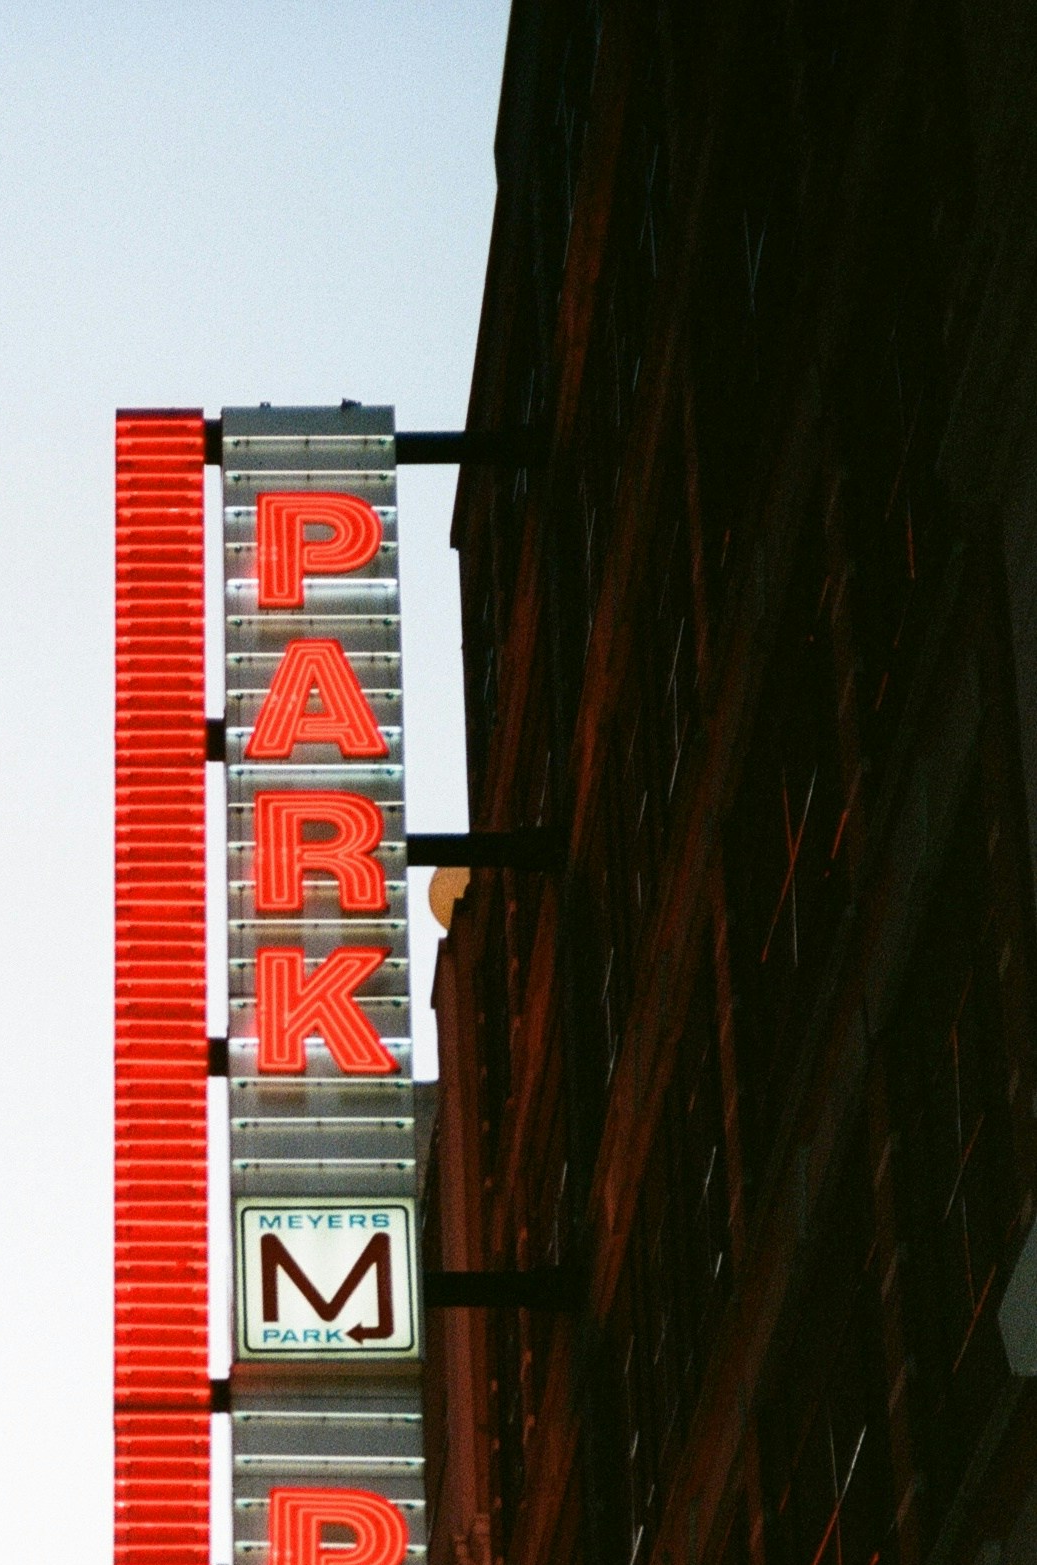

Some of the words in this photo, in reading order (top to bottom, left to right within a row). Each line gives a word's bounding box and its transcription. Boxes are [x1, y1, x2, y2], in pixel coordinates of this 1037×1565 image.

[245, 491, 400, 1074] PARK
[259, 1213, 391, 1230] MEYERS
[263, 1328, 345, 1343] PARK
